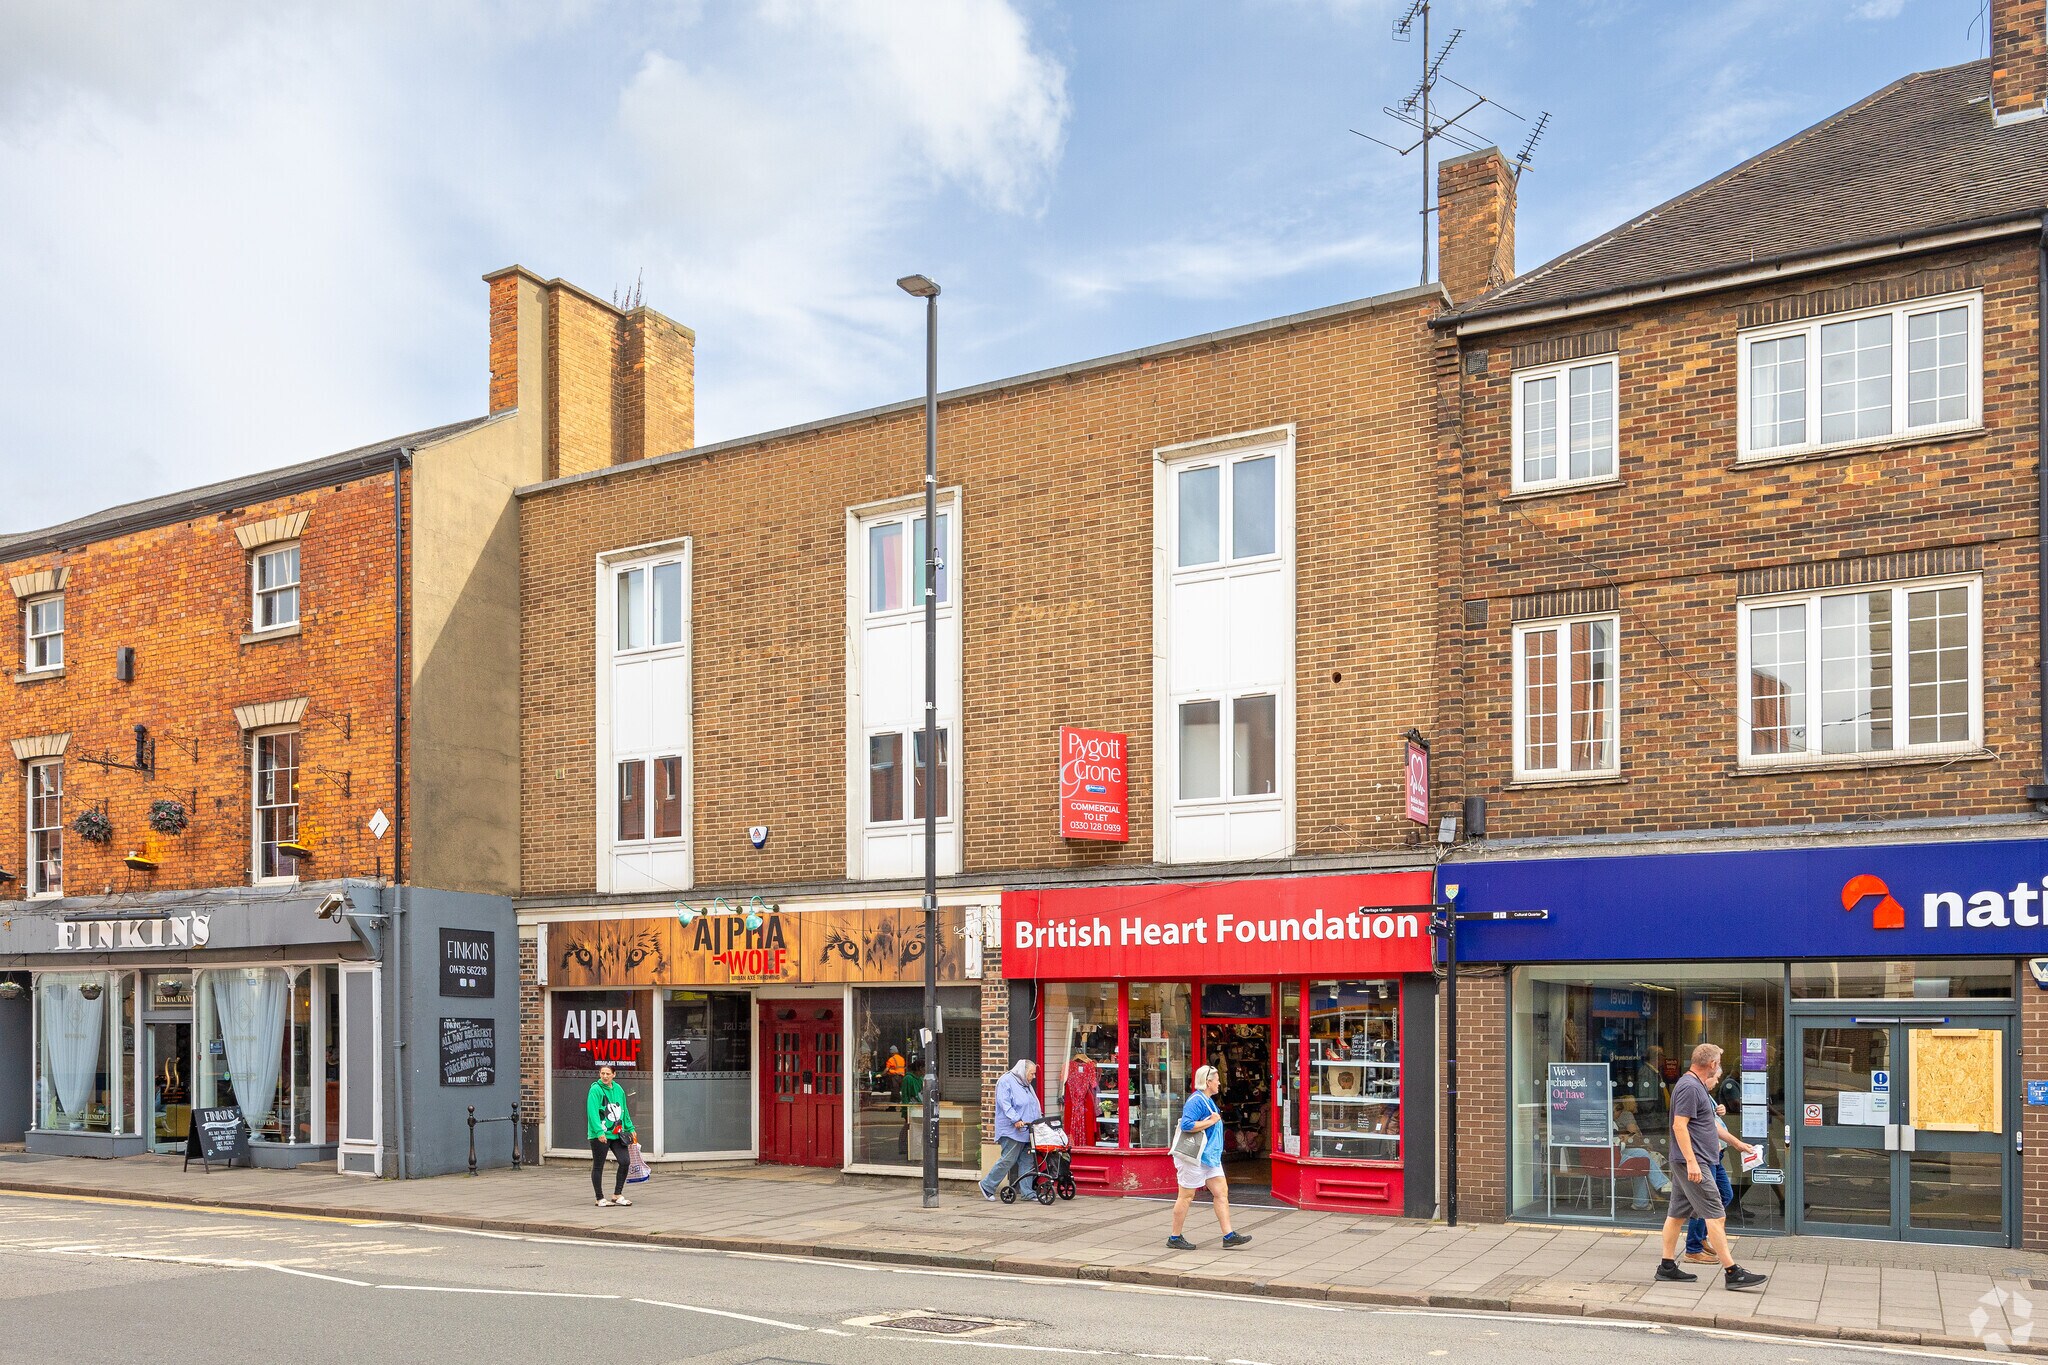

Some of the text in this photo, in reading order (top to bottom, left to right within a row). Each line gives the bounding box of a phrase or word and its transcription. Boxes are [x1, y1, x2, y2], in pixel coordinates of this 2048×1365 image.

[1069, 733, 1120, 762] Pygott
[1074, 759, 1121, 782] Crone
[1070, 802, 1120, 814] COMMERCIAL
[1070, 821, 1121, 832] 0330 128 0939
[54, 910, 210, 950] FINKIN'S
[1015, 919, 1111, 949] British
[1120, 917, 1208, 946] Heart
[1216, 908, 1419, 944] Foundation
[728, 950, 786, 975] WOLF
[449, 964, 466, 974] 01476
[591, 1040, 641, 1060] WOLF
[1553, 1066, 1576, 1076] We've
[1553, 1078, 1588, 1089] changed.
[1552, 1089, 1584, 1098] Or have
[1553, 1101, 1568, 1110] we?
